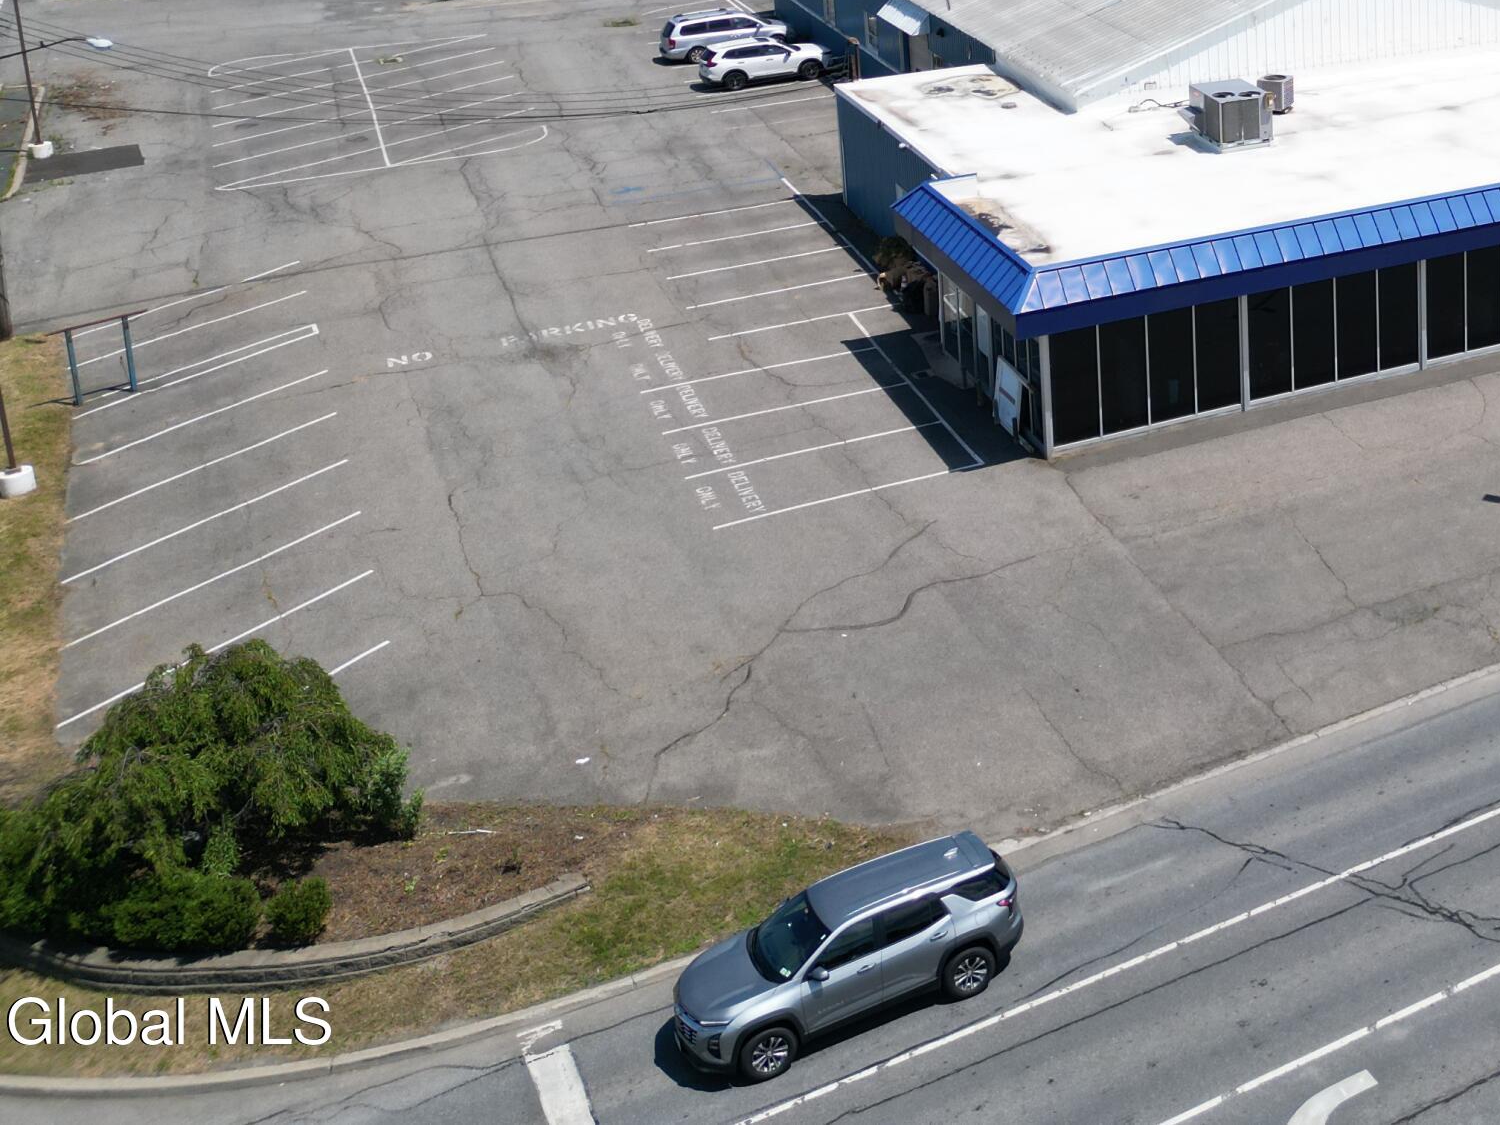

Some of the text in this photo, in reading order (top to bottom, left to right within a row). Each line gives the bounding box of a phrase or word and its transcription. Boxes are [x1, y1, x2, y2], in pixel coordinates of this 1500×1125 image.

[386, 351, 432, 368] NO
[702, 426, 737, 464] DELIVERY
[696, 485, 721, 510] ONLY
[728, 470, 767, 513] DELIVERY
